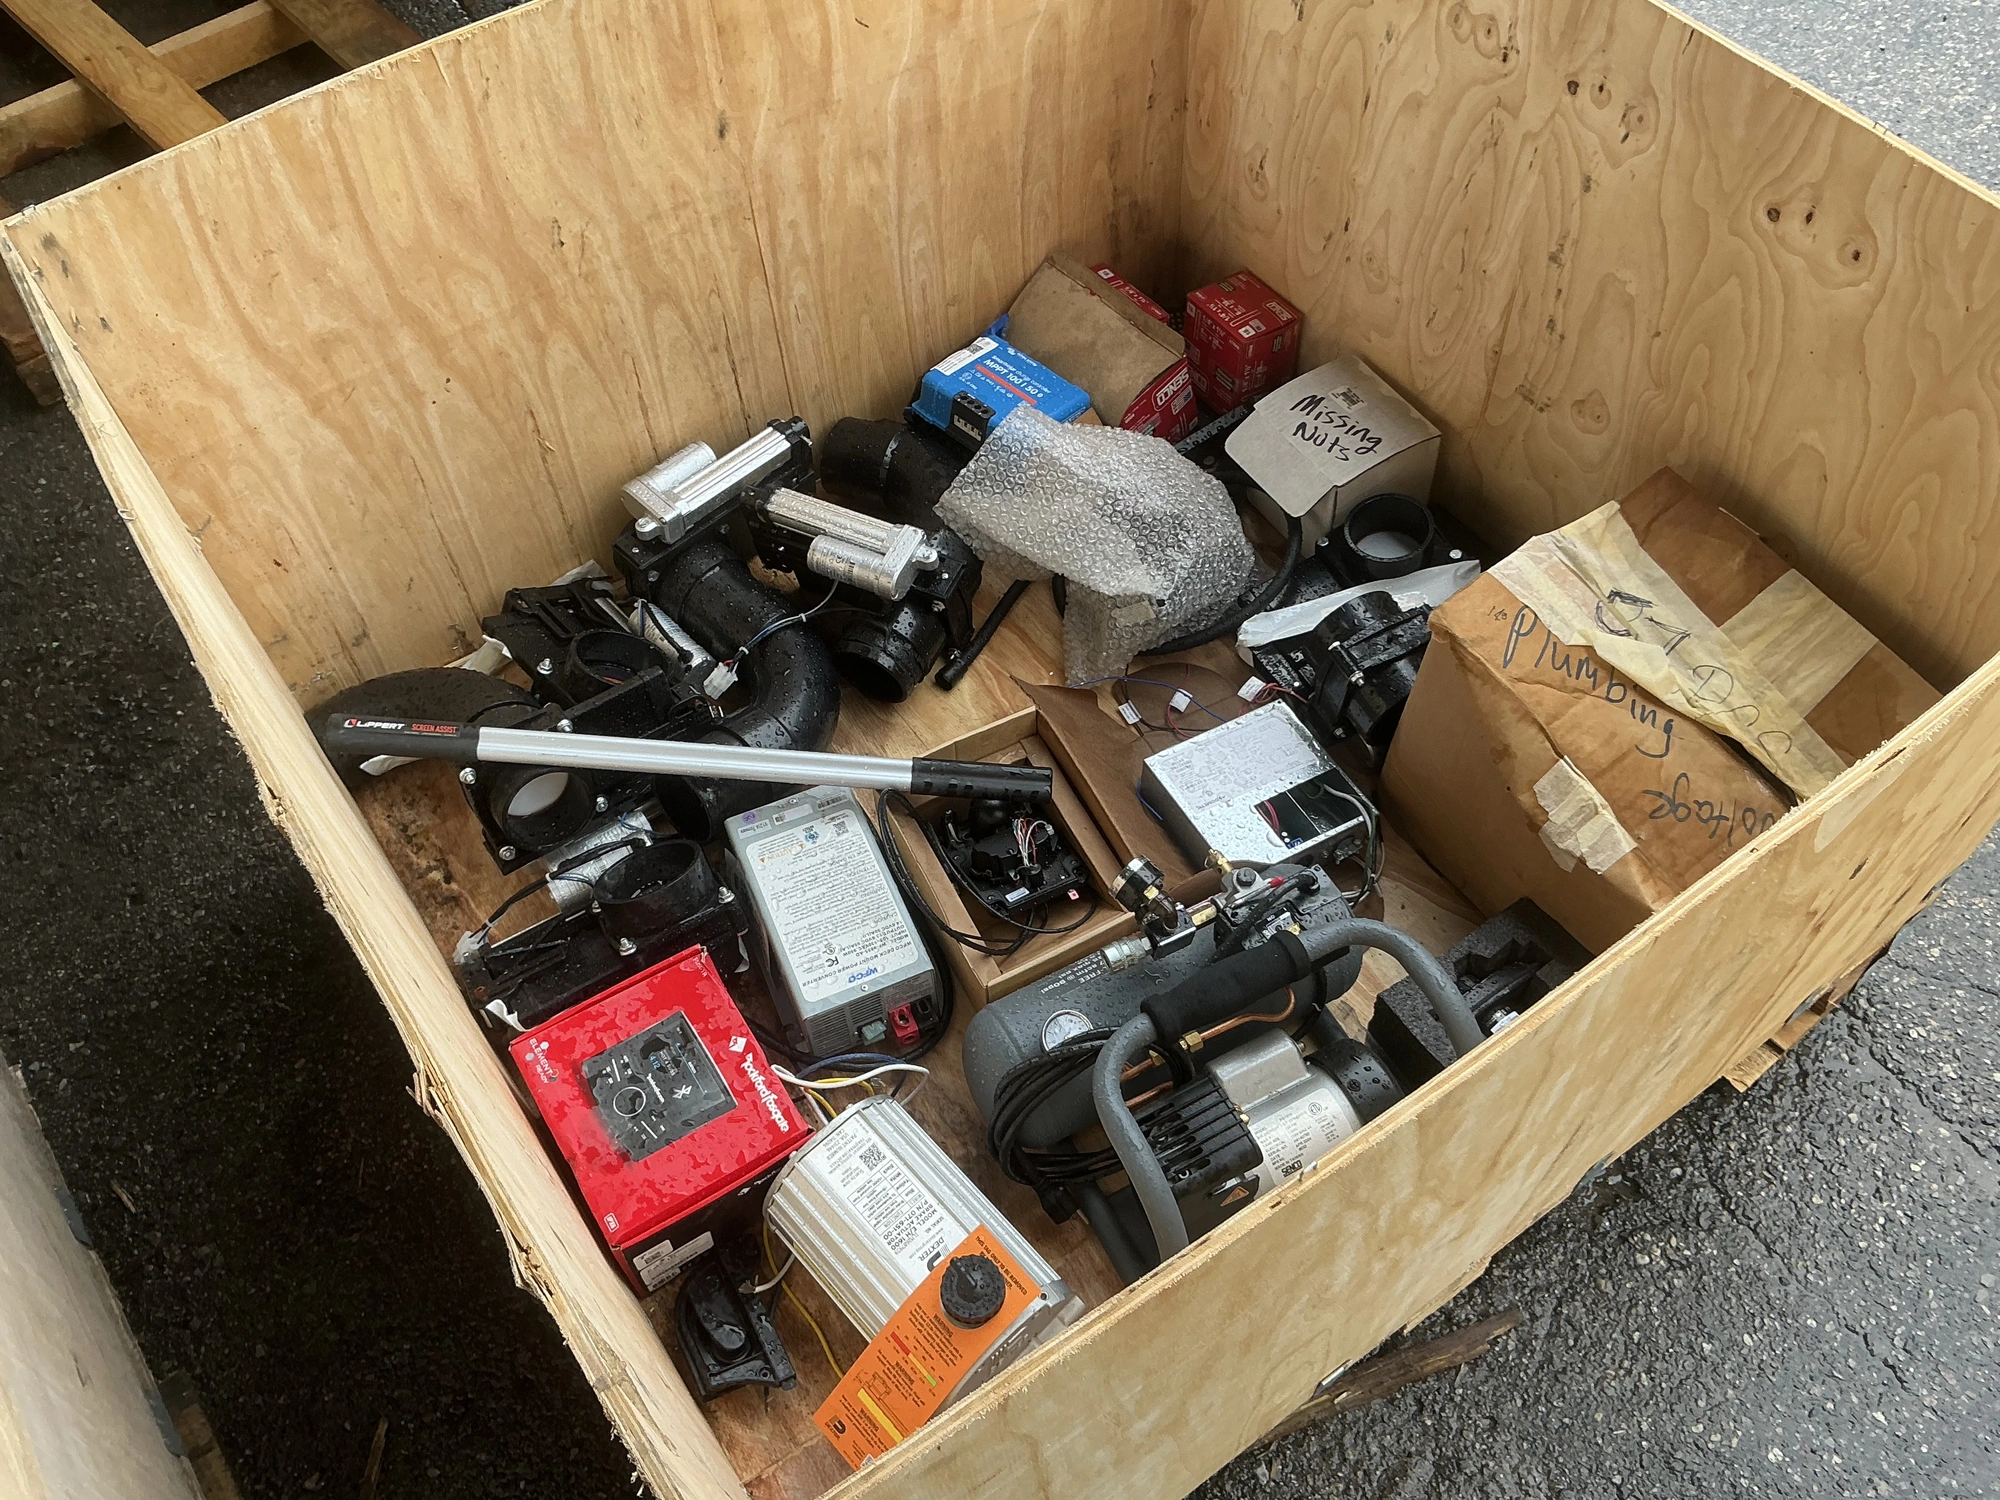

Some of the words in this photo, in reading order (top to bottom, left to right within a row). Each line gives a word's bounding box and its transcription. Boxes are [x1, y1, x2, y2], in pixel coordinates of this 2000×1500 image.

[983, 357, 1008, 376] MPPT
[1005, 371, 1022, 386] 100
[1025, 384, 1038, 396] 50
[1150, 366, 1194, 406] SENCO
[1289, 394, 1382, 455] Missing
[1292, 421, 1351, 461] Nuts
[1502, 604, 1673, 758] Plumbing
[357, 720, 405, 730] LIPPERT
[412, 723, 434, 732] SCREEN
[435, 725, 458, 734] ASSIST
[878, 947, 894, 956] DECK
[894, 941, 911, 950] WFCO
[836, 961, 858, 973] POWER
[857, 954, 878, 965] MOUNT
[801, 969, 836, 987] CONVERTER
[846, 966, 878, 983] WFCO
[528, 1037, 553, 1075] ELEMENT
[648, 1054, 661, 1069] 4:12
[534, 1063, 549, 1084] READY
[745, 1053, 777, 1101] Rockford
[760, 1091, 790, 1133] Fosgate
[825, 1144, 843, 1160] NUMBER
[1280, 1159, 1303, 1177] SENCO
[894, 1177, 909, 1191] Yellow
[904, 1187, 914, 1197] Blue
[913, 1202, 933, 1221] BRAKE
[914, 1198, 928, 1211] P/N
[881, 1209, 917, 1240] 071-651-00
[882, 1209, 904, 1228] FUNCTION
[915, 1207, 938, 1227] MODEL
[885, 1218, 915, 1246] ACTUATOR
[904, 1225, 917, 1238] E/H
[889, 1235, 906, 1250] 1600
[916, 1236, 945, 1262] DEXTER
[974, 1235, 985, 1246] THIS
[982, 1244, 992, 1254] TAG
[989, 1252, 1001, 1264] ONLY
[998, 1262, 1005, 1270] TO
[1003, 1268, 1011, 1276] BE
[1008, 1274, 1028, 1295] REMOVED
[931, 1313, 954, 1338] WARNING
[893, 1360, 915, 1385] WARNING
[858, 1407, 880, 1432] WARNING
